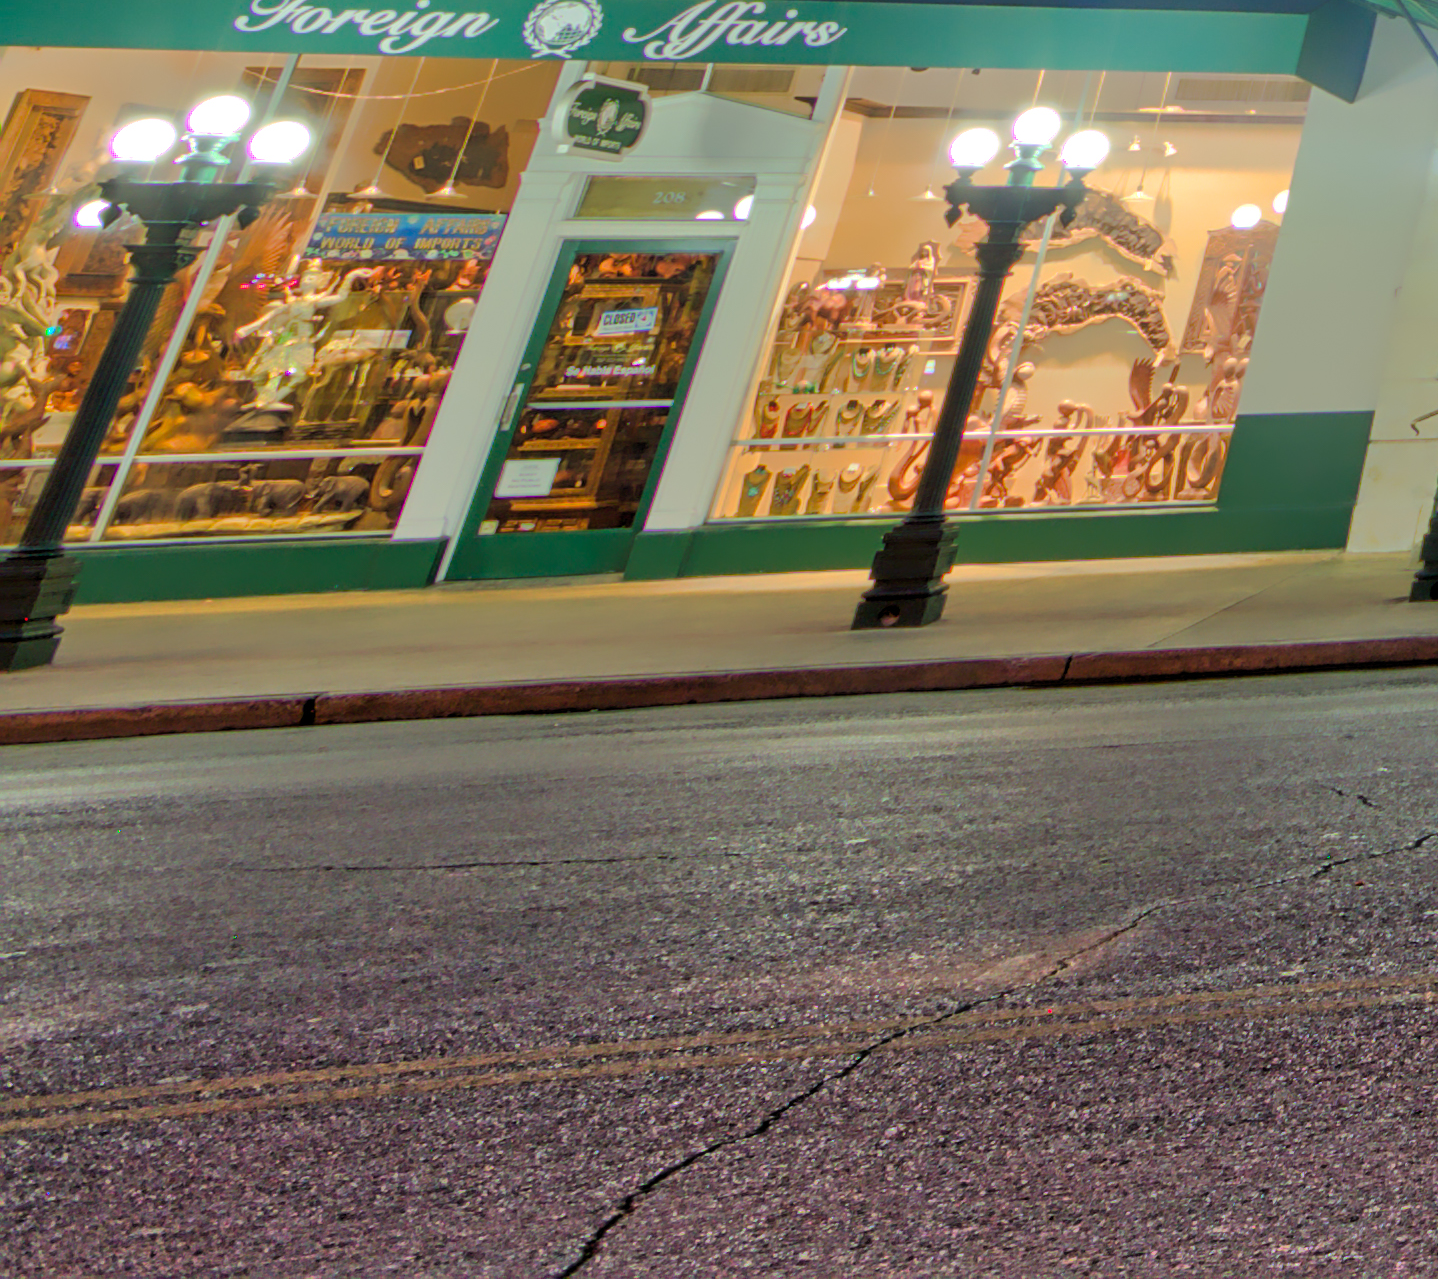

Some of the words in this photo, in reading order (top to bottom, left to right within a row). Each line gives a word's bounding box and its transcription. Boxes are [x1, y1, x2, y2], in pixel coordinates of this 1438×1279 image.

[622, 0, 848, 60] Affairs
[652, 191, 686, 204] 208
[326, 217, 399, 234] FOREIGN
[419, 218, 492, 235] AFFAIRS
[320, 236, 375, 249] WORLD
[385, 237, 406, 249] OF
[414, 237, 484, 250] IMPORTS
[603, 312, 637, 326] CLOSED
